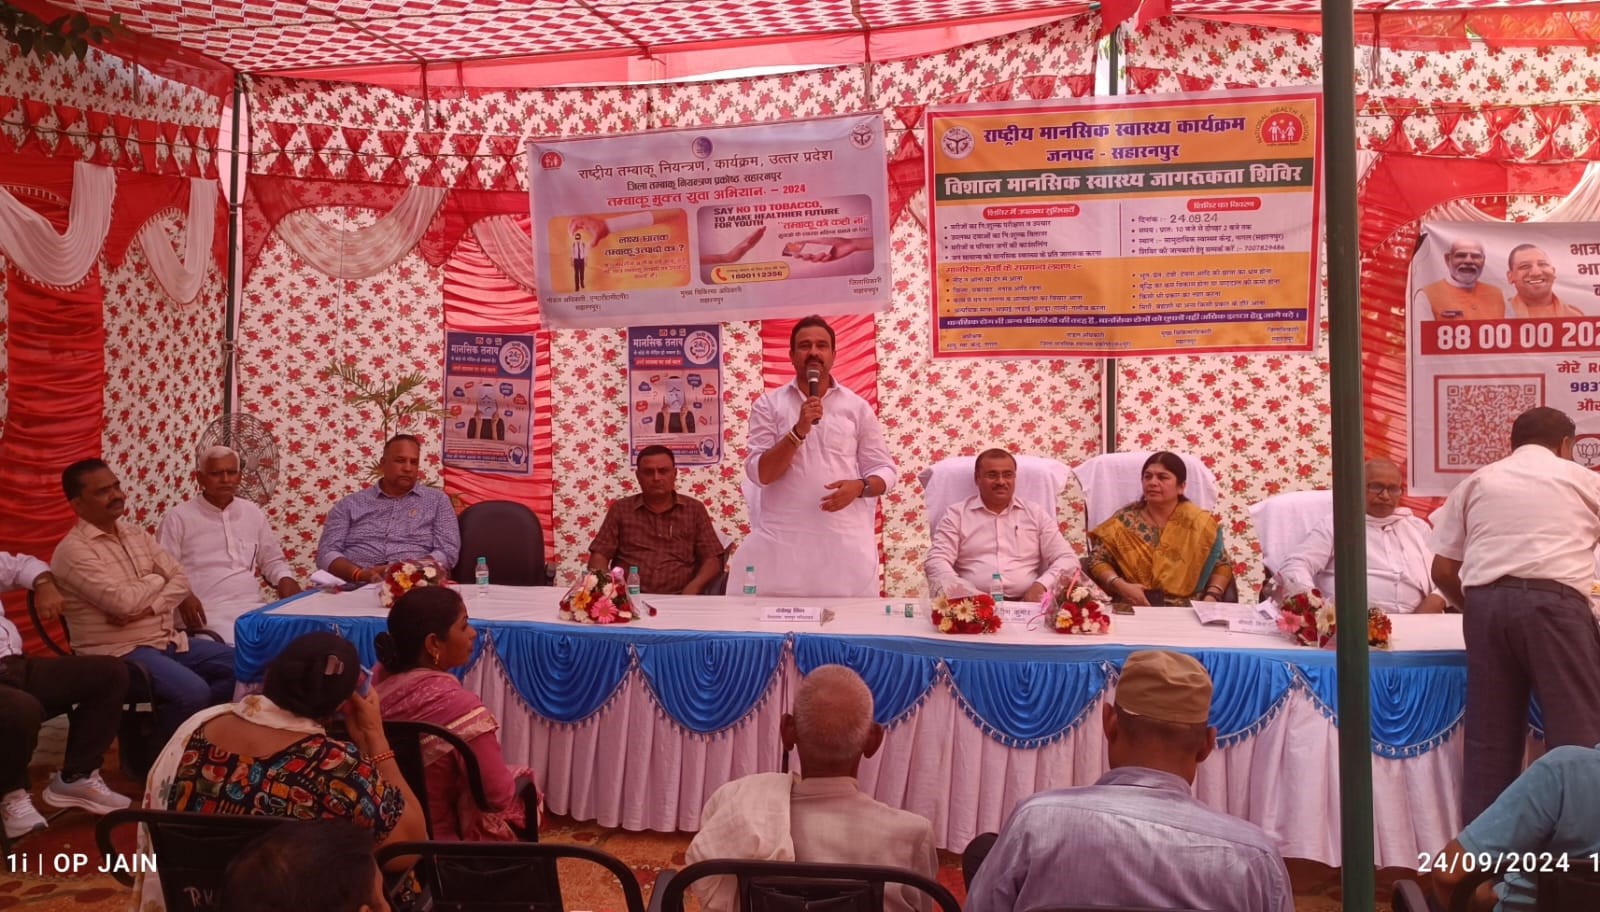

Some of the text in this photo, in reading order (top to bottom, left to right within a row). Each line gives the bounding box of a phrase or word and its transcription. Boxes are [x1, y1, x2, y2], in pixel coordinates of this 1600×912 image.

[983, 124, 1034, 146] राष्ट्रीय
[1039, 121, 1110, 140] मानसिक
[1115, 120, 1172, 137] स्वास्थ्य
[1176, 114, 1246, 133] कार्यक्रम
[1046, 148, 1095, 162] जनपद
[1111, 144, 1180, 161] सहारनपुर
[578, 165, 613, 180] राष्ट्रीय
[616, 164, 657, 178] तम्बाकू
[768, 152, 799, 165] उत्तर
[803, 147, 833, 162] प्रदेश
[627, 181, 647, 191] जिला
[744, 172, 783, 182] सहारनपुर
[944, 163, 1304, 196] विशाल मानसिक स्वास्थ्य जागरूकता शिविर
[607, 194, 651, 208] तम्बाकू
[652, 192, 682, 206] मुक्त
[686, 191, 710, 204] युवा
[783, 184, 806, 194] 2024
[713, 207, 735, 216] SAY
[736, 205, 751, 215] NO
[754, 204, 767, 213] TO
[714, 208, 840, 224] TO MAKE HEALTHIER FUTURE
[714, 219, 764, 230] FOR YOUTH
[678, 244, 685, 252] ?
[1437, 325, 1471, 350] 88
[1478, 324, 1511, 350] 00
[1520, 322, 1554, 348] 00
[1556, 360, 1600, 374] मेरे R
[1570, 381, 1600, 393] 983
